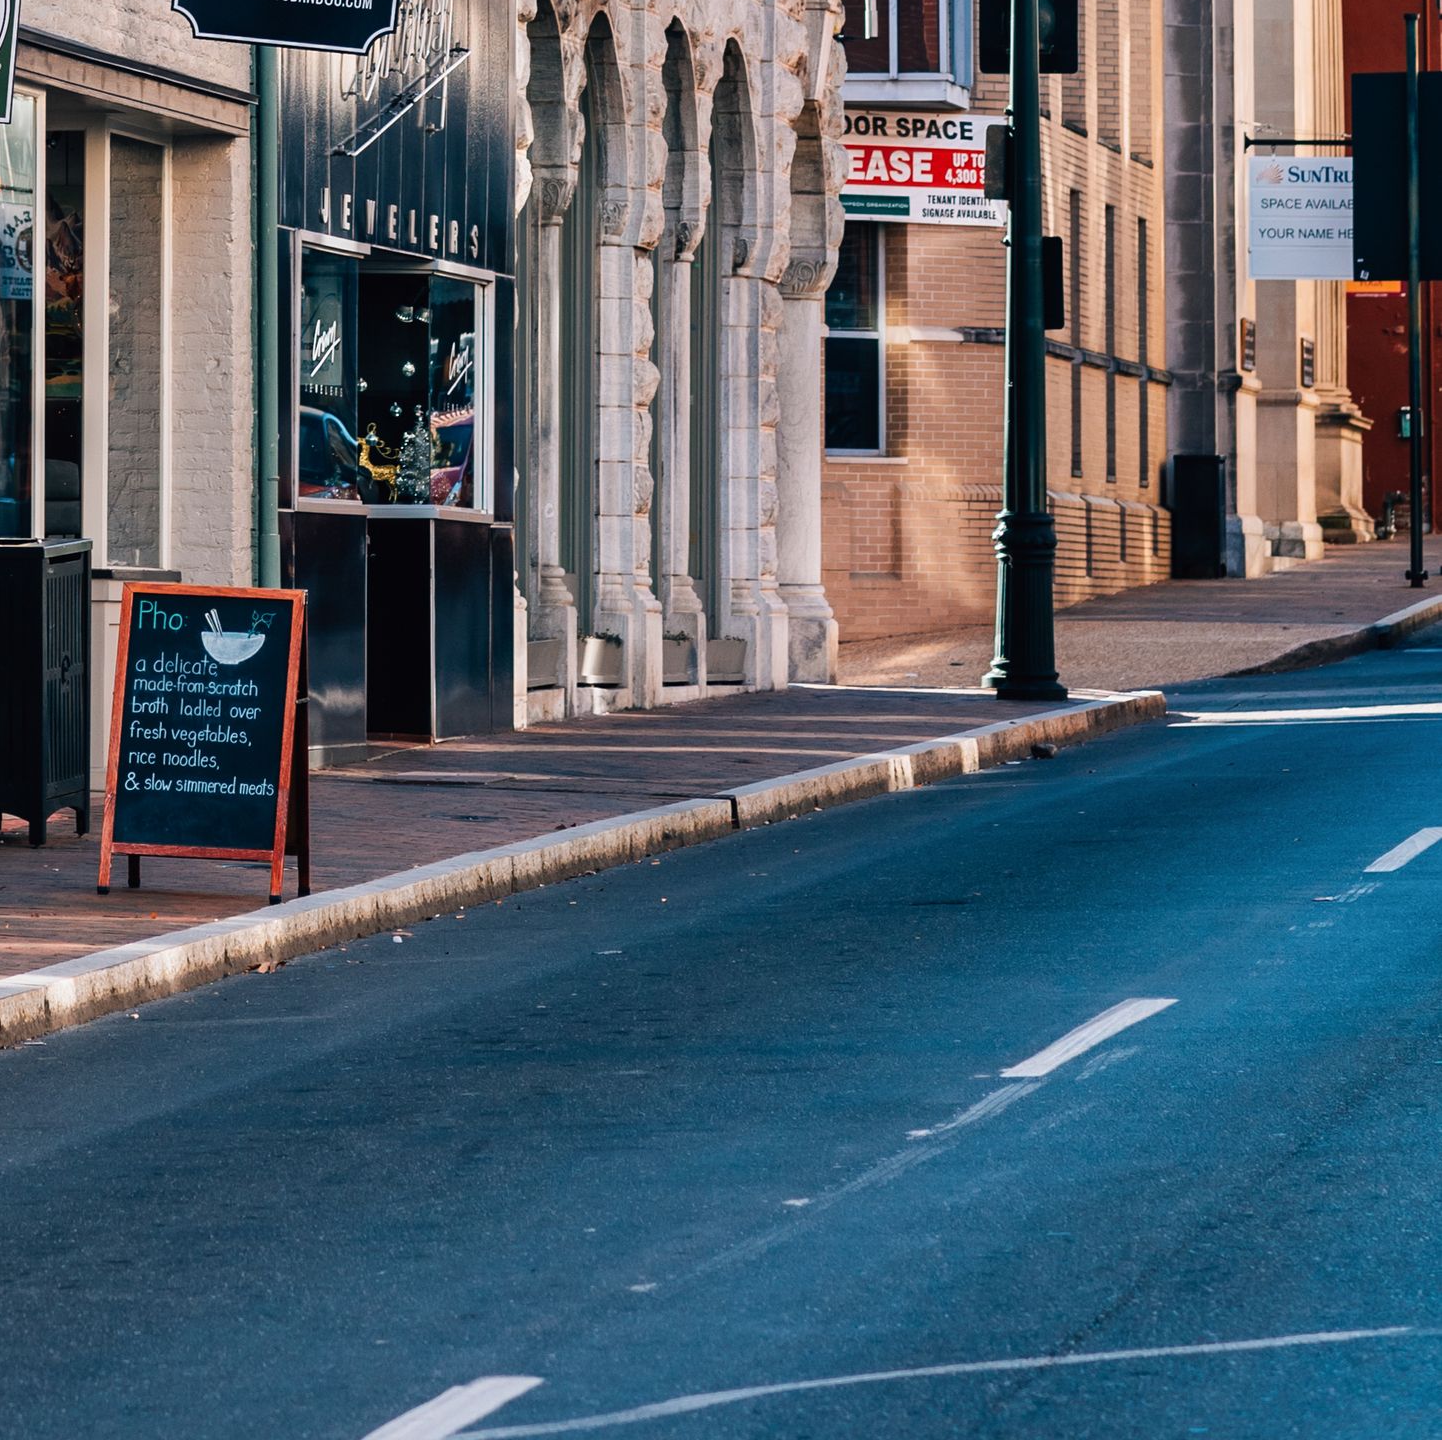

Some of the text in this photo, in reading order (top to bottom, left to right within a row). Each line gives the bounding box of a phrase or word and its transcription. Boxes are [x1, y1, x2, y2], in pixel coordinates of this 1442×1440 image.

[896, 118, 974, 141] SPACE
[847, 150, 934, 184] EASE
[952, 152, 969, 168] UP
[945, 168, 978, 186] 4,300
[1288, 165, 1353, 184] SUNTRU
[927, 194, 957, 206] TENANT
[1260, 198, 1353, 210] SPACE AVAILAB
[318, 186, 480, 260] JEWELERS
[922, 208, 997, 221] SIGNAGE AVAILABLE
[1258, 227, 1353, 240] YOUR NAME HE
[138, 599, 189, 631] Pho:
[135, 651, 218, 677] a delicate,
[133, 674, 259, 697] made-from-scratch
[131, 695, 262, 720] broth ladled over
[129, 719, 253, 748] fresh vegetables,
[128, 748, 220, 770] rice noodles,
[124, 771, 275, 797] & slow simmered meats
